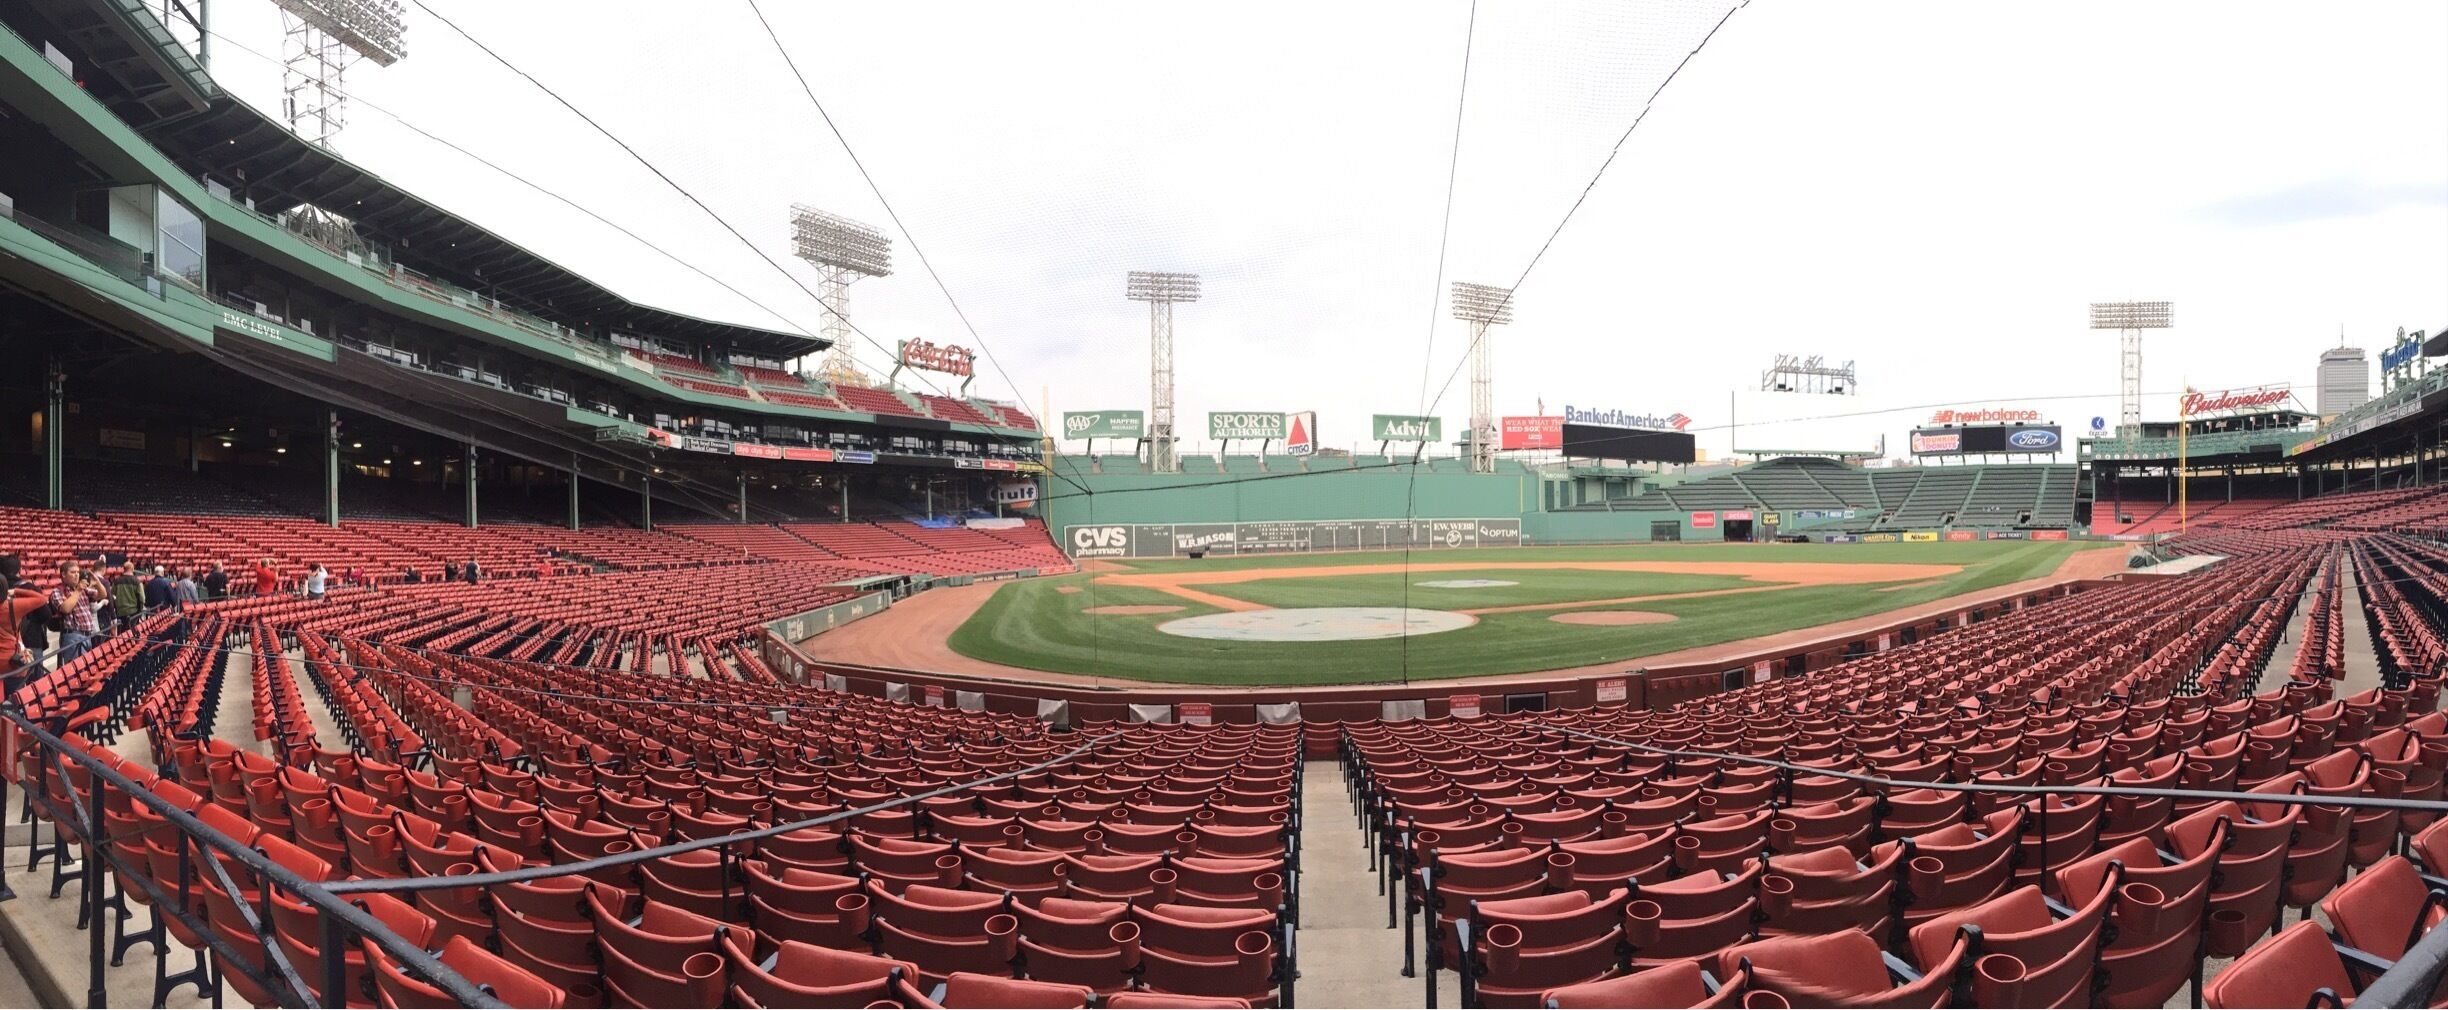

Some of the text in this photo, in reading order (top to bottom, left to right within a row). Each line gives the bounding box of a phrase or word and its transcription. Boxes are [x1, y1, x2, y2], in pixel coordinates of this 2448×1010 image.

[224, 312, 283, 341] EMC LEVEL
[2180, 390, 2290, 416] Budweiser
[1213, 414, 1280, 428] SPORTS
[1383, 419, 1431, 437] Advil
[2018, 431, 2049, 446] Ford
[1287, 444, 1309, 455] CITGO
[1074, 528, 1127, 547] CVS
[1489, 529, 1518, 537] OPTUM
[1076, 546, 1125, 557] pharmacy
